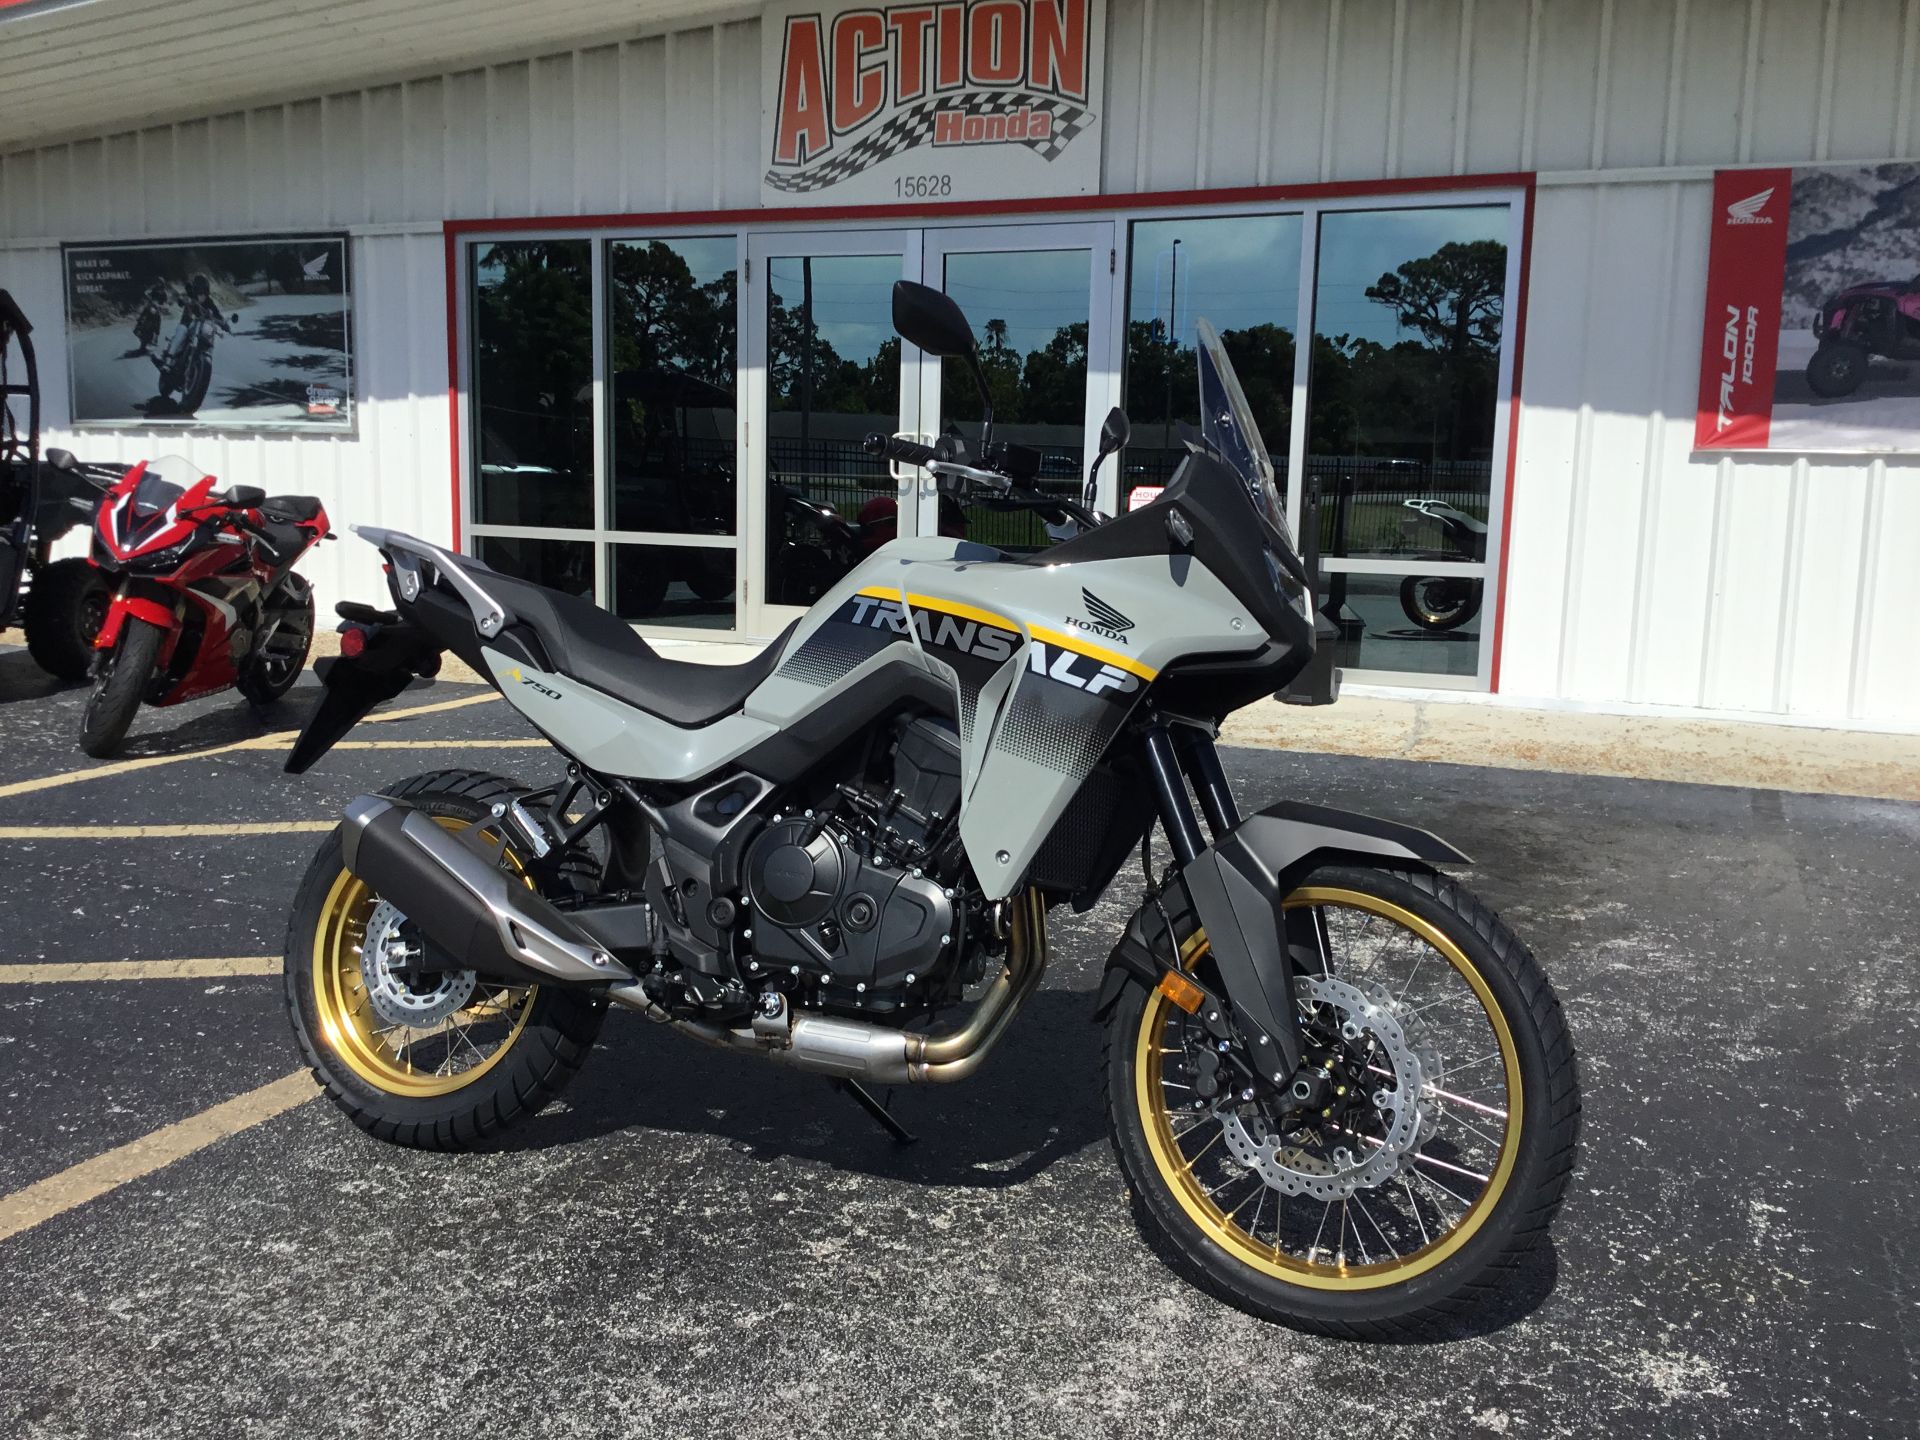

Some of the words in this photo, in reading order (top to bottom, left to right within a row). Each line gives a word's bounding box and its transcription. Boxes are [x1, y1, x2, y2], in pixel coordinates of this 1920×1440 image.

[772, 0, 1092, 166] ACTION
[932, 105, 1053, 147] Honda
[894, 174, 952, 198] 15628
[1727, 215, 1774, 225] HONDA
[1742, 305, 1759, 385] 1000R
[1717, 304, 1741, 432] TALON
[1135, 491, 1157, 499] HOU
[1064, 616, 1128, 645] HONDA
[521, 676, 562, 700] 750
